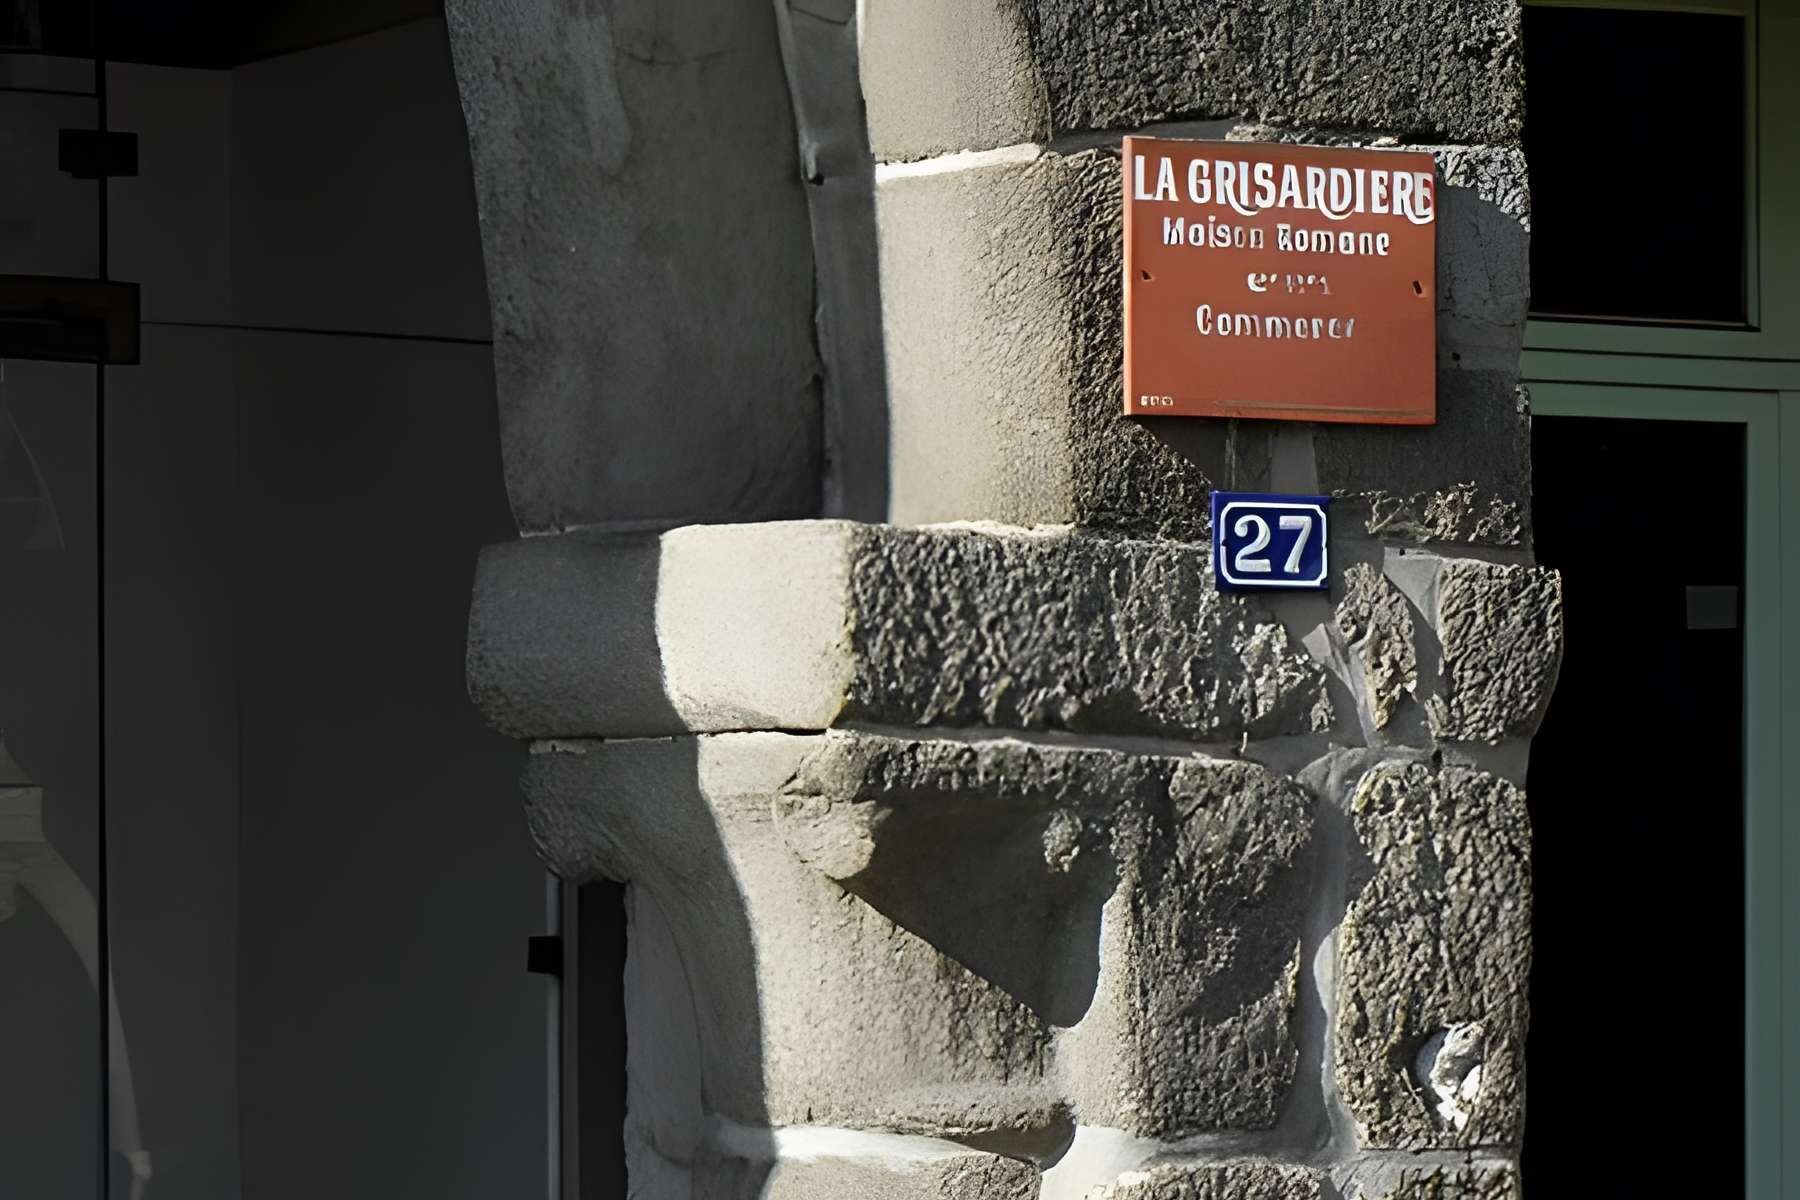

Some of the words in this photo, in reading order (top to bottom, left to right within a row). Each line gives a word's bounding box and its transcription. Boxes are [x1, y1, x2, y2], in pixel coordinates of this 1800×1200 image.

[1133, 154, 1179, 202] LA
[1187, 158, 1436, 225] GRISARDIERE
[1162, 214, 1265, 249] Maison
[1276, 223, 1390, 256] Romane
[1234, 514, 1312, 573] 27
